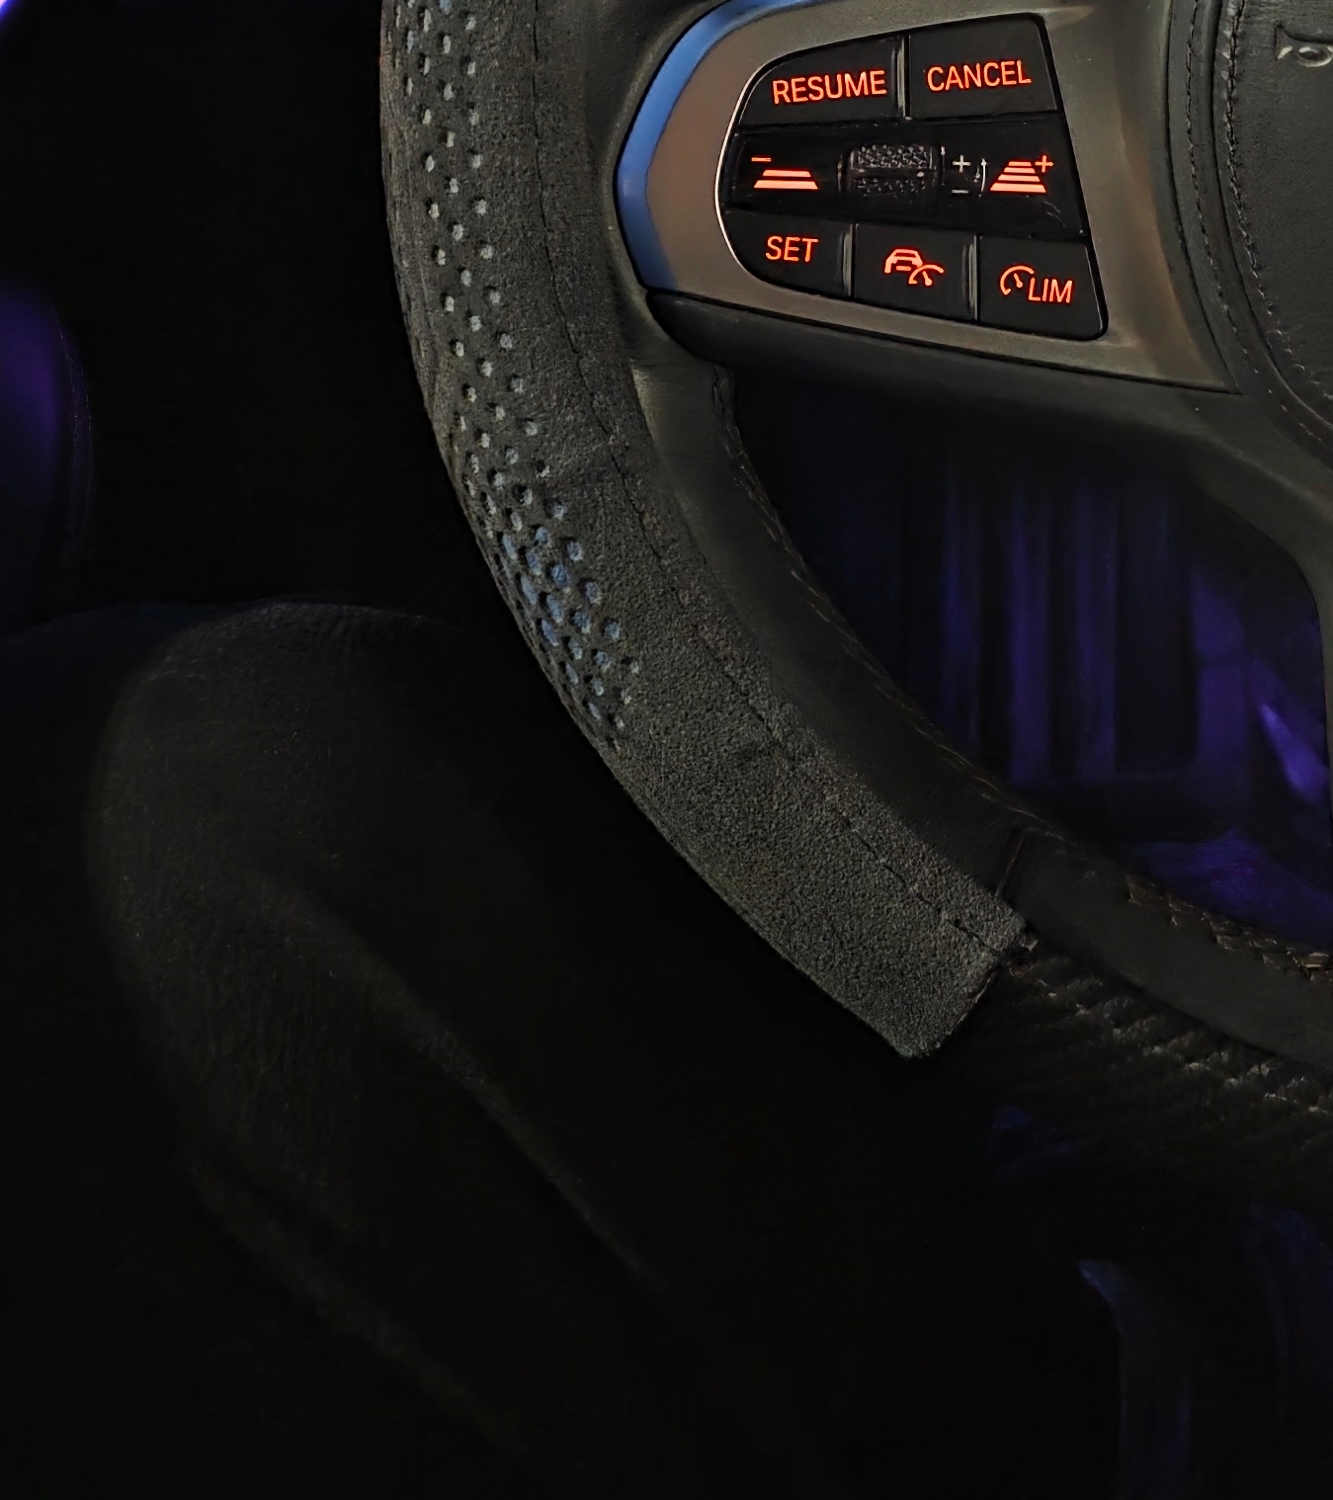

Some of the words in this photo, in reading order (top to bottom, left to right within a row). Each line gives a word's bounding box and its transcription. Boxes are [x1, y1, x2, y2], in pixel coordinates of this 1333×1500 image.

[772, 70, 887, 105] RESUME
[927, 60, 1032, 93] CANCEL
[765, 236, 819, 263] SET
[1027, 277, 1074, 304] LIM
